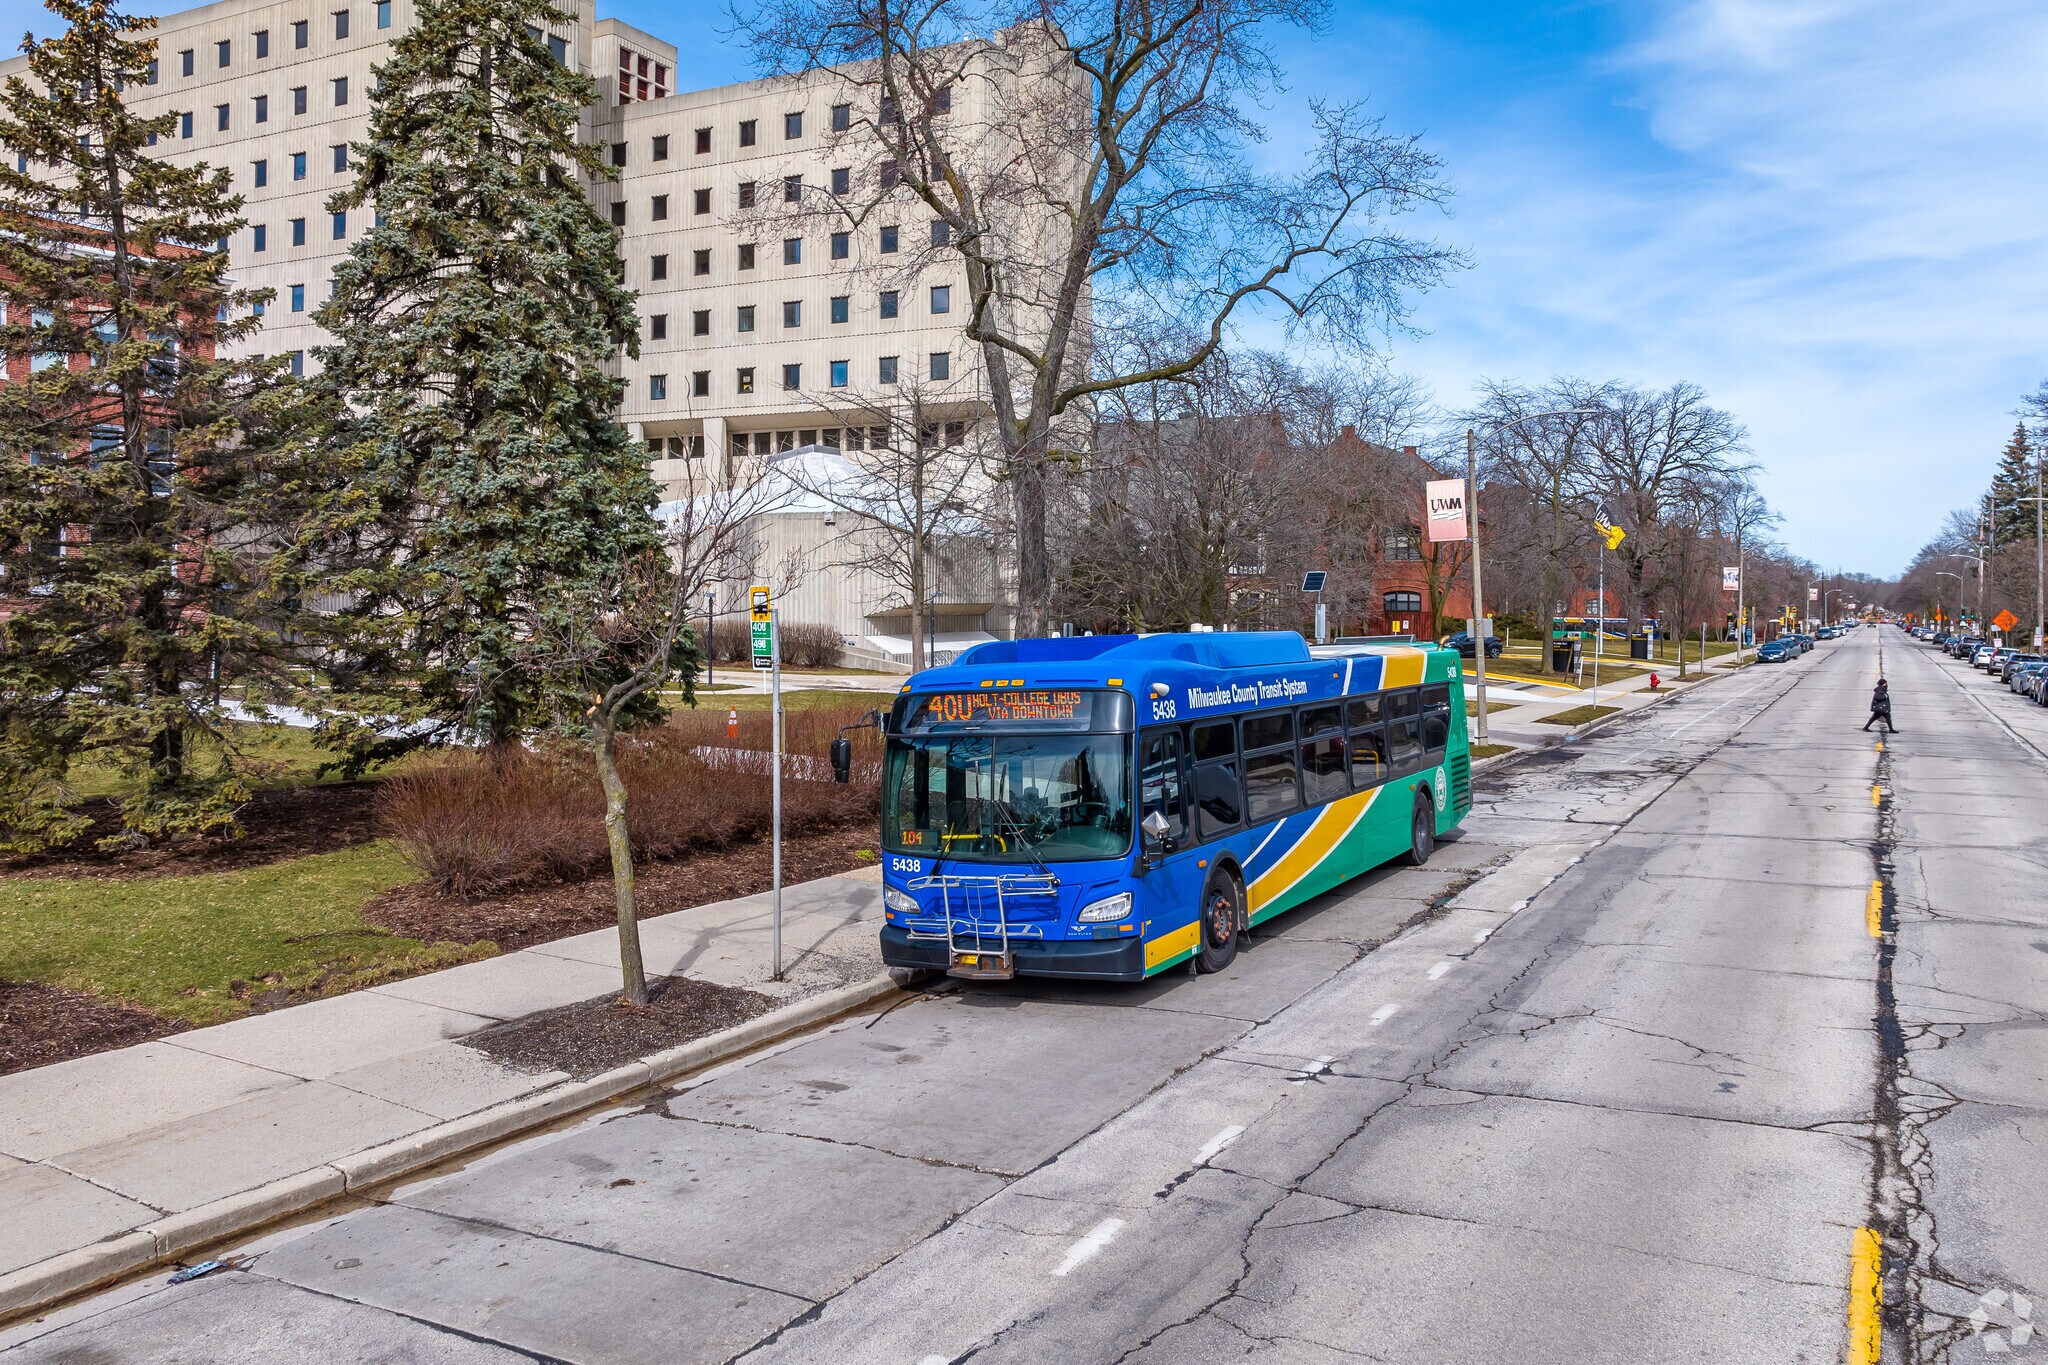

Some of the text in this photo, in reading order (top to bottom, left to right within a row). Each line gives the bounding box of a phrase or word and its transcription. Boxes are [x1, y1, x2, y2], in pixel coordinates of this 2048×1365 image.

[1430, 497, 1462, 513] UWM
[972, 691, 1050, 707] HOLT-COLLEGE
[1187, 678, 1308, 709] Milwaukee County Transit System
[928, 694, 972, 721] 40U
[988, 704, 1073, 719] VIA DOWNTOWN
[1152, 699, 1177, 721] 5438
[892, 857, 921, 872] 5438
